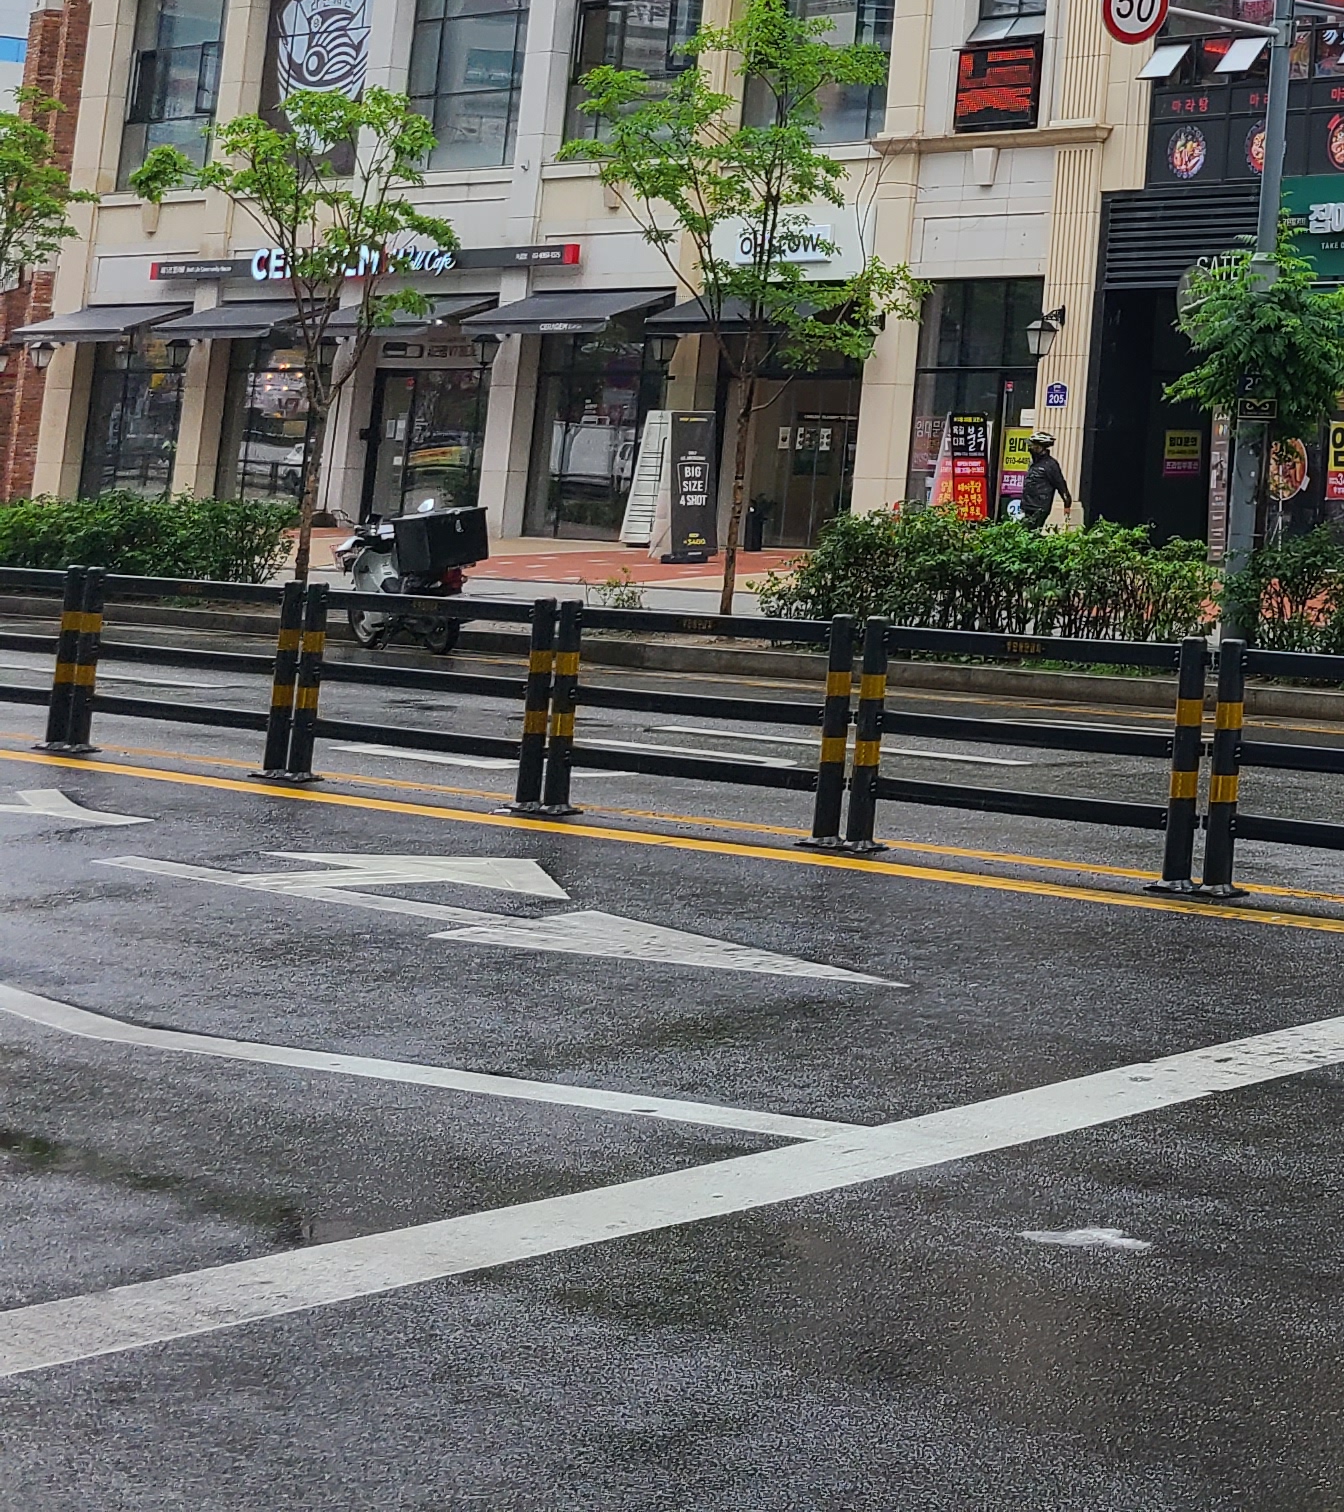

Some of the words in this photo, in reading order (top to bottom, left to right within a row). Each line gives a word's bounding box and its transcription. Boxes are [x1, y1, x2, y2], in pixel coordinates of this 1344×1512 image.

[1320, 241, 1338, 251] TAKE
[684, 466, 702, 478] BIG
[682, 480, 704, 492] SIZE
[686, 494, 708, 506] SHOT
